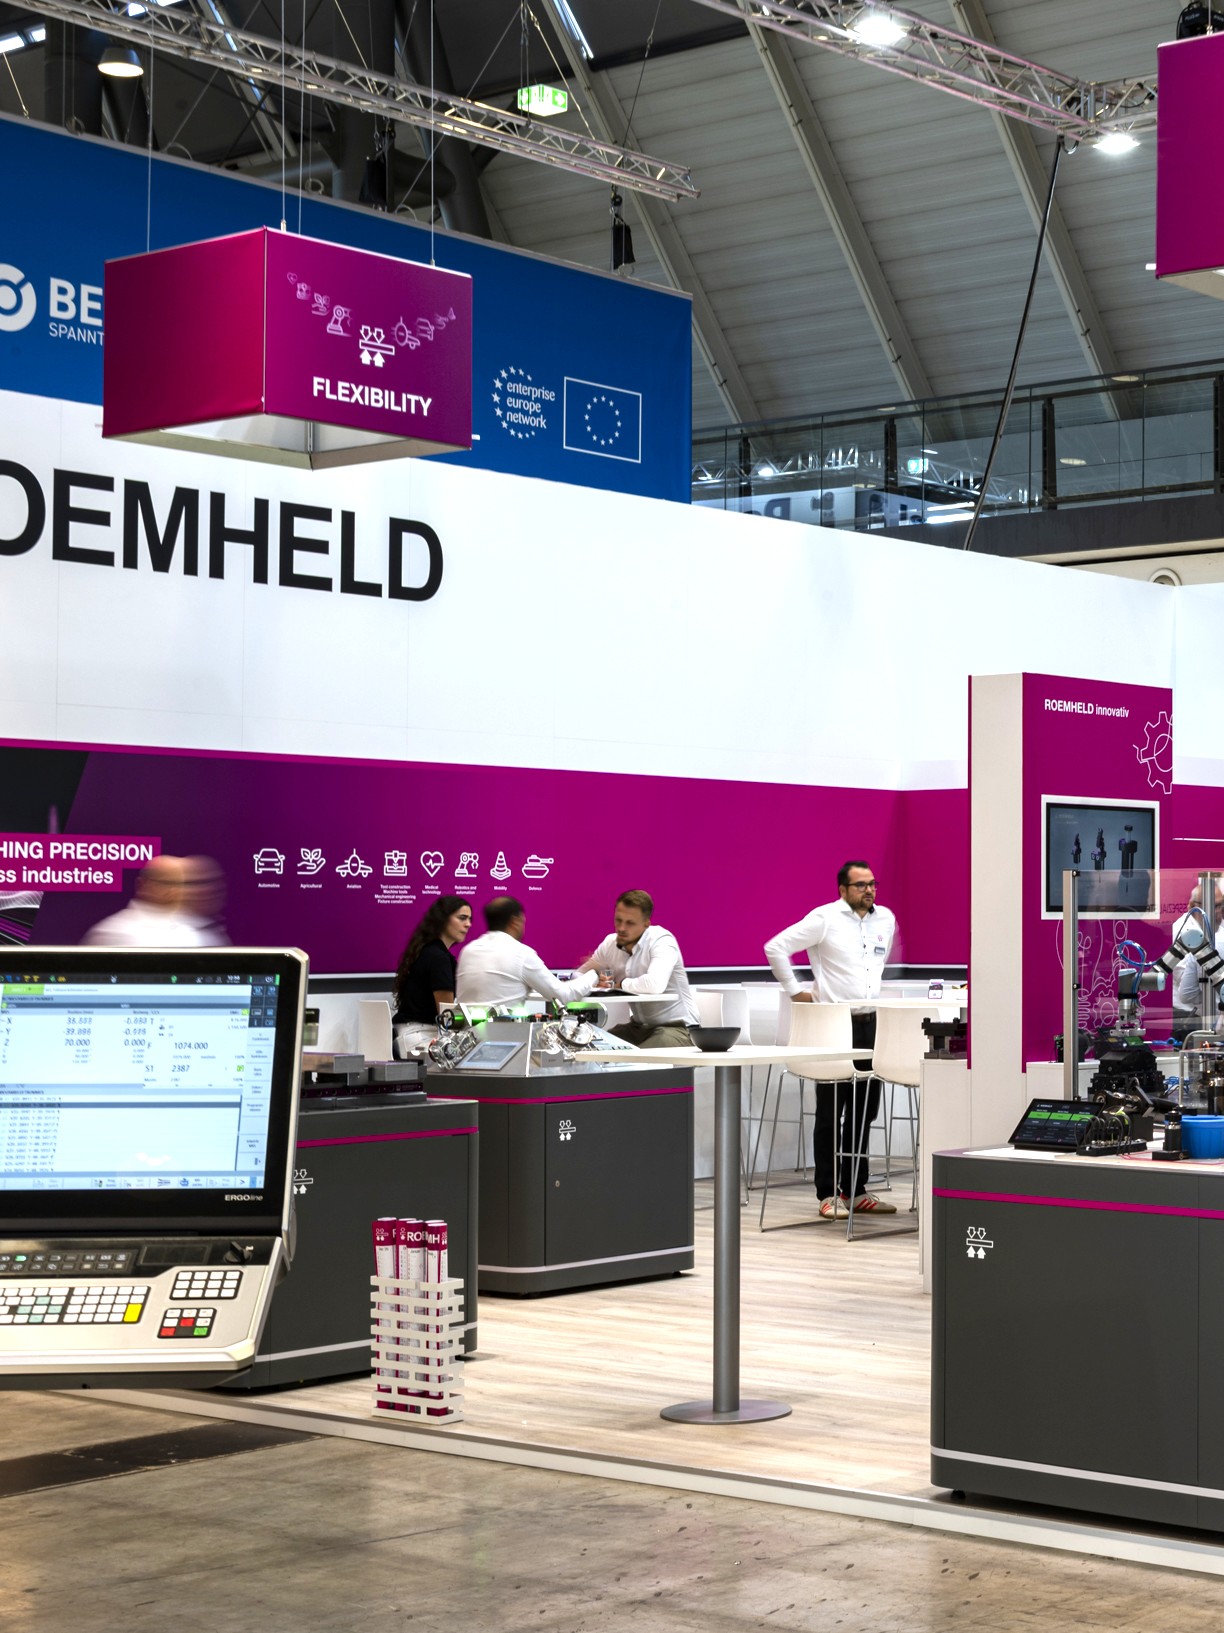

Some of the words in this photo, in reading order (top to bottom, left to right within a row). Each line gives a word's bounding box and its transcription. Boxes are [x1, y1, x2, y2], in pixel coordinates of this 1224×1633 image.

[313, 376, 432, 416] FLEXIBILITY
[507, 382, 555, 401] enterprise
[507, 396, 541, 414] europe
[507, 411, 546, 429] network
[1045, 699, 1094, 714] ROEMHELD
[1095, 704, 1129, 718] innovativ
[50, 842, 153, 860] PRECISION
[22, 866, 114, 884] industries
[174, 1042, 208, 1050] 1074.000
